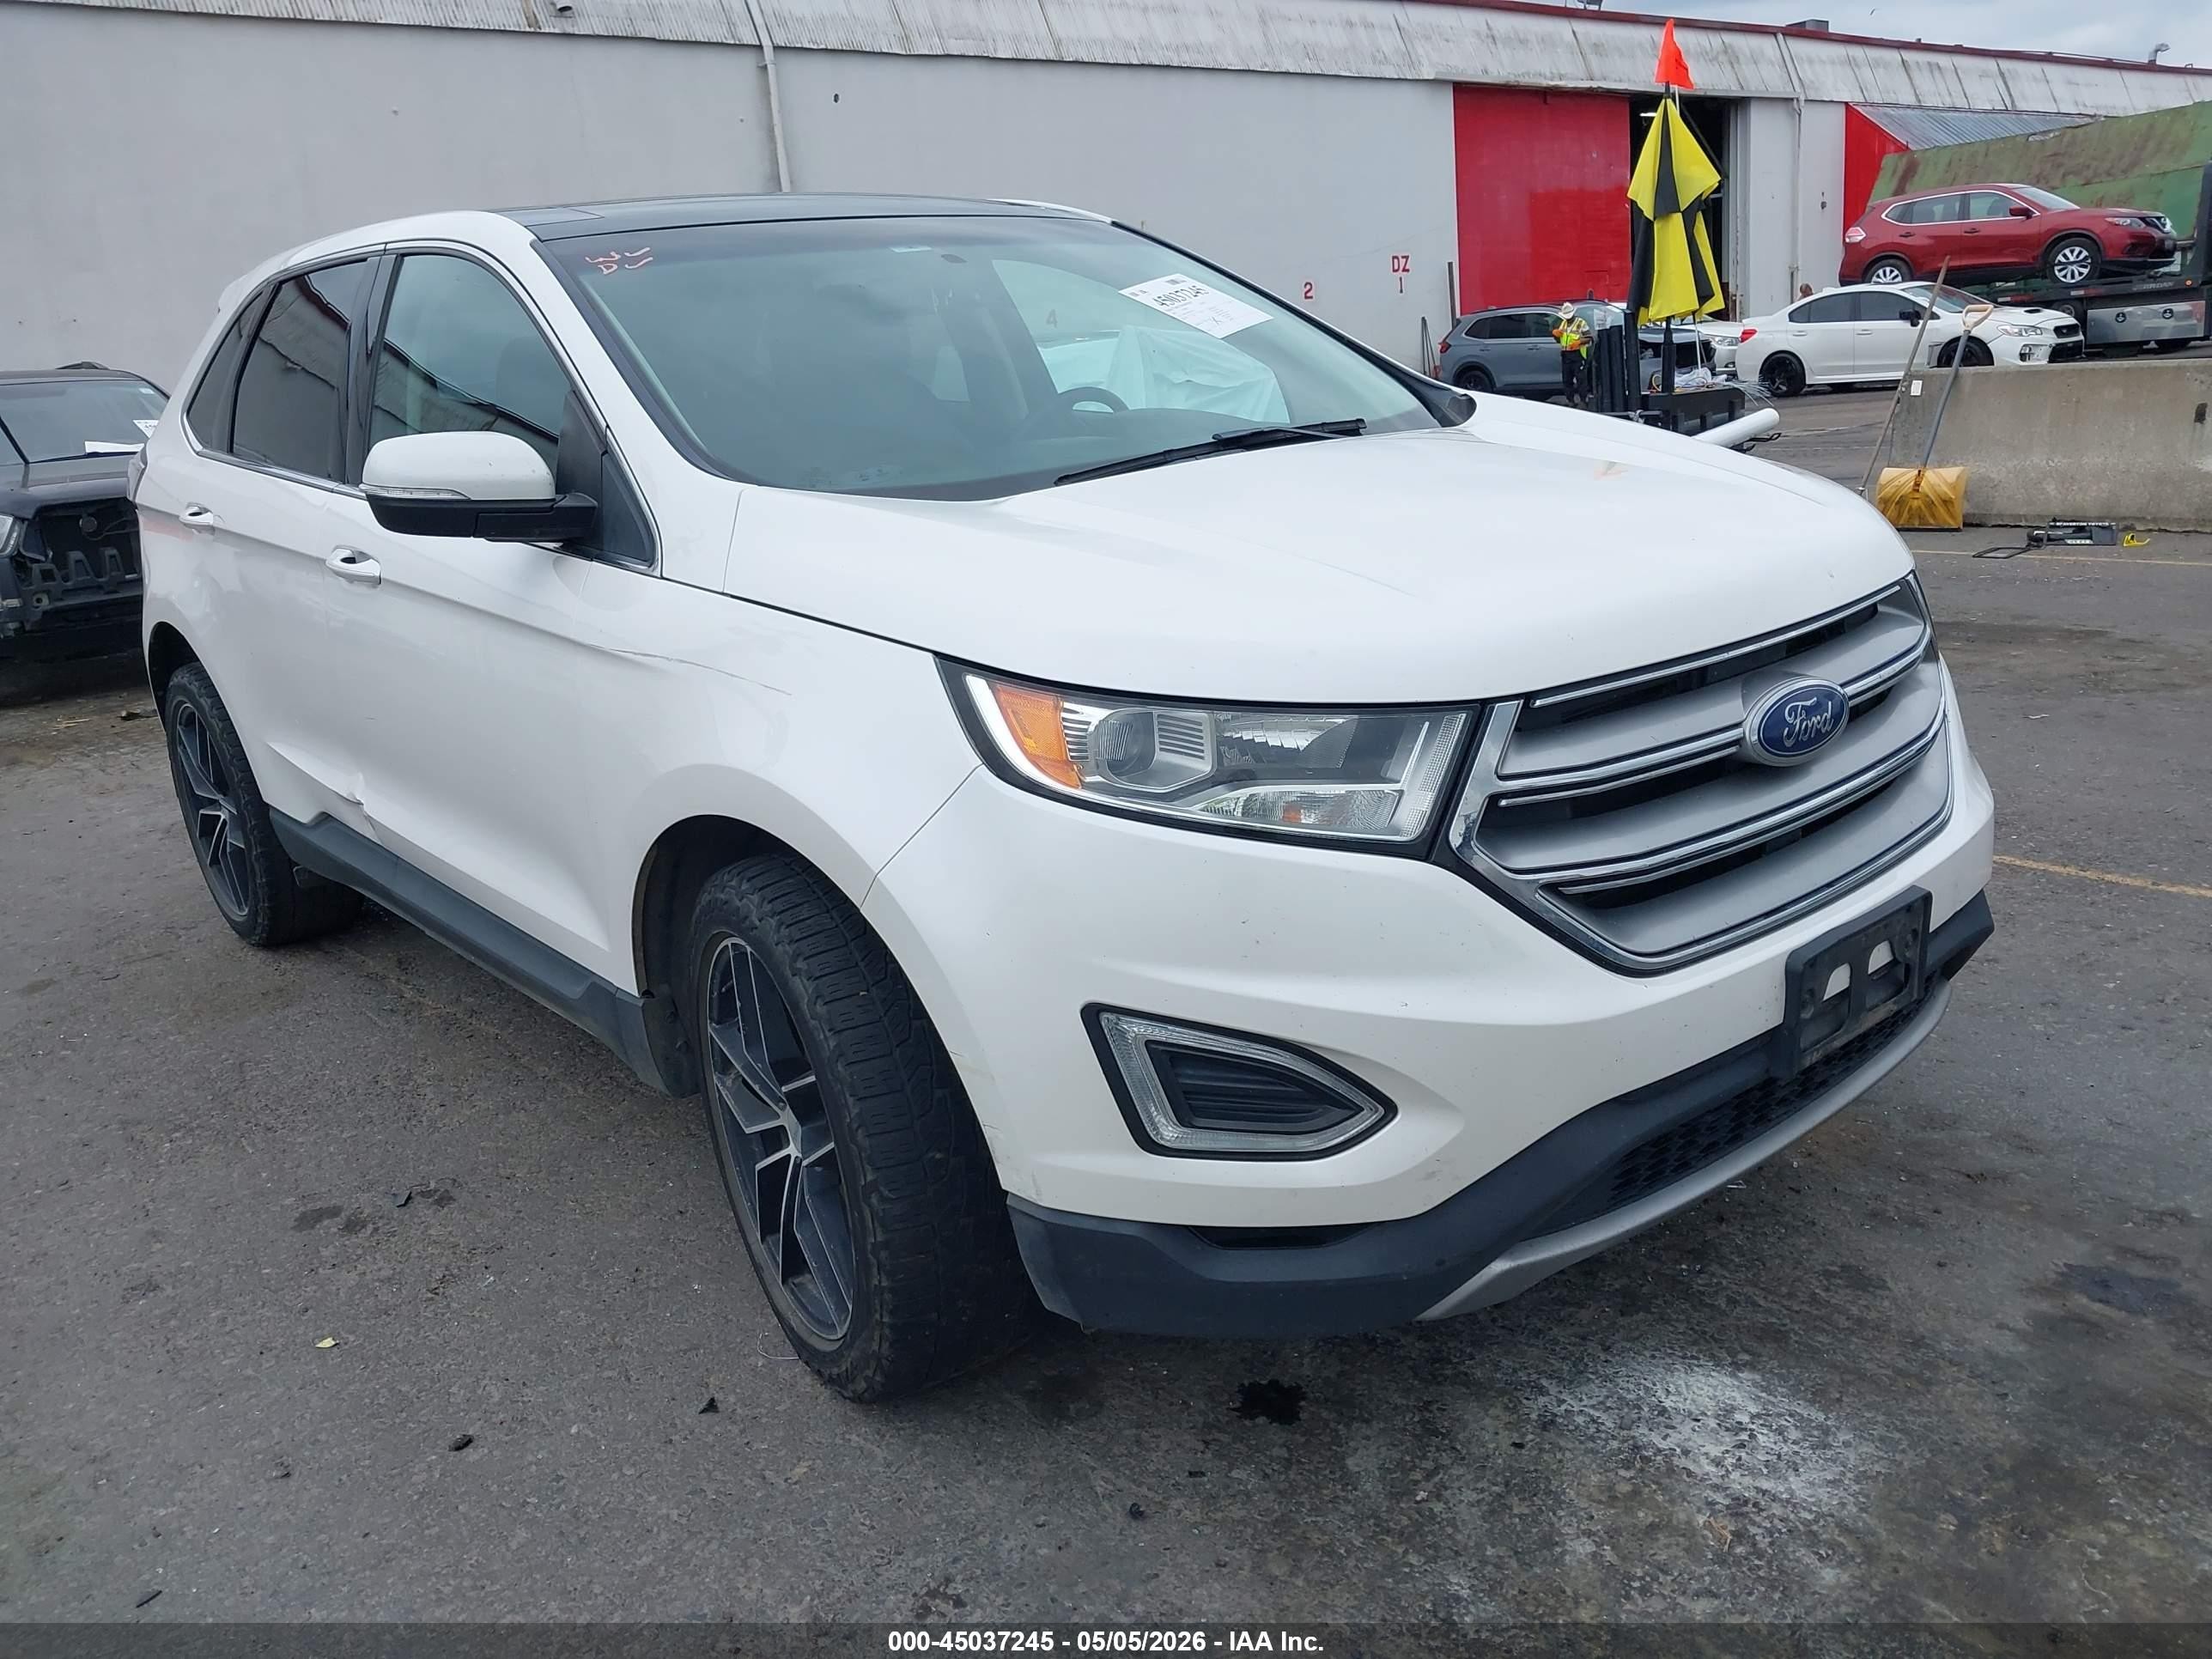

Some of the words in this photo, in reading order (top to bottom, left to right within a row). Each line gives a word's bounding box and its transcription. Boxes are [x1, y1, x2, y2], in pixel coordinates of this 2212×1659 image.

[1392, 256, 1410, 272] DZ
[1152, 284, 1209, 307] 45037245
[1304, 282, 1314, 300] 2
[1784, 696, 1834, 747] Ford
